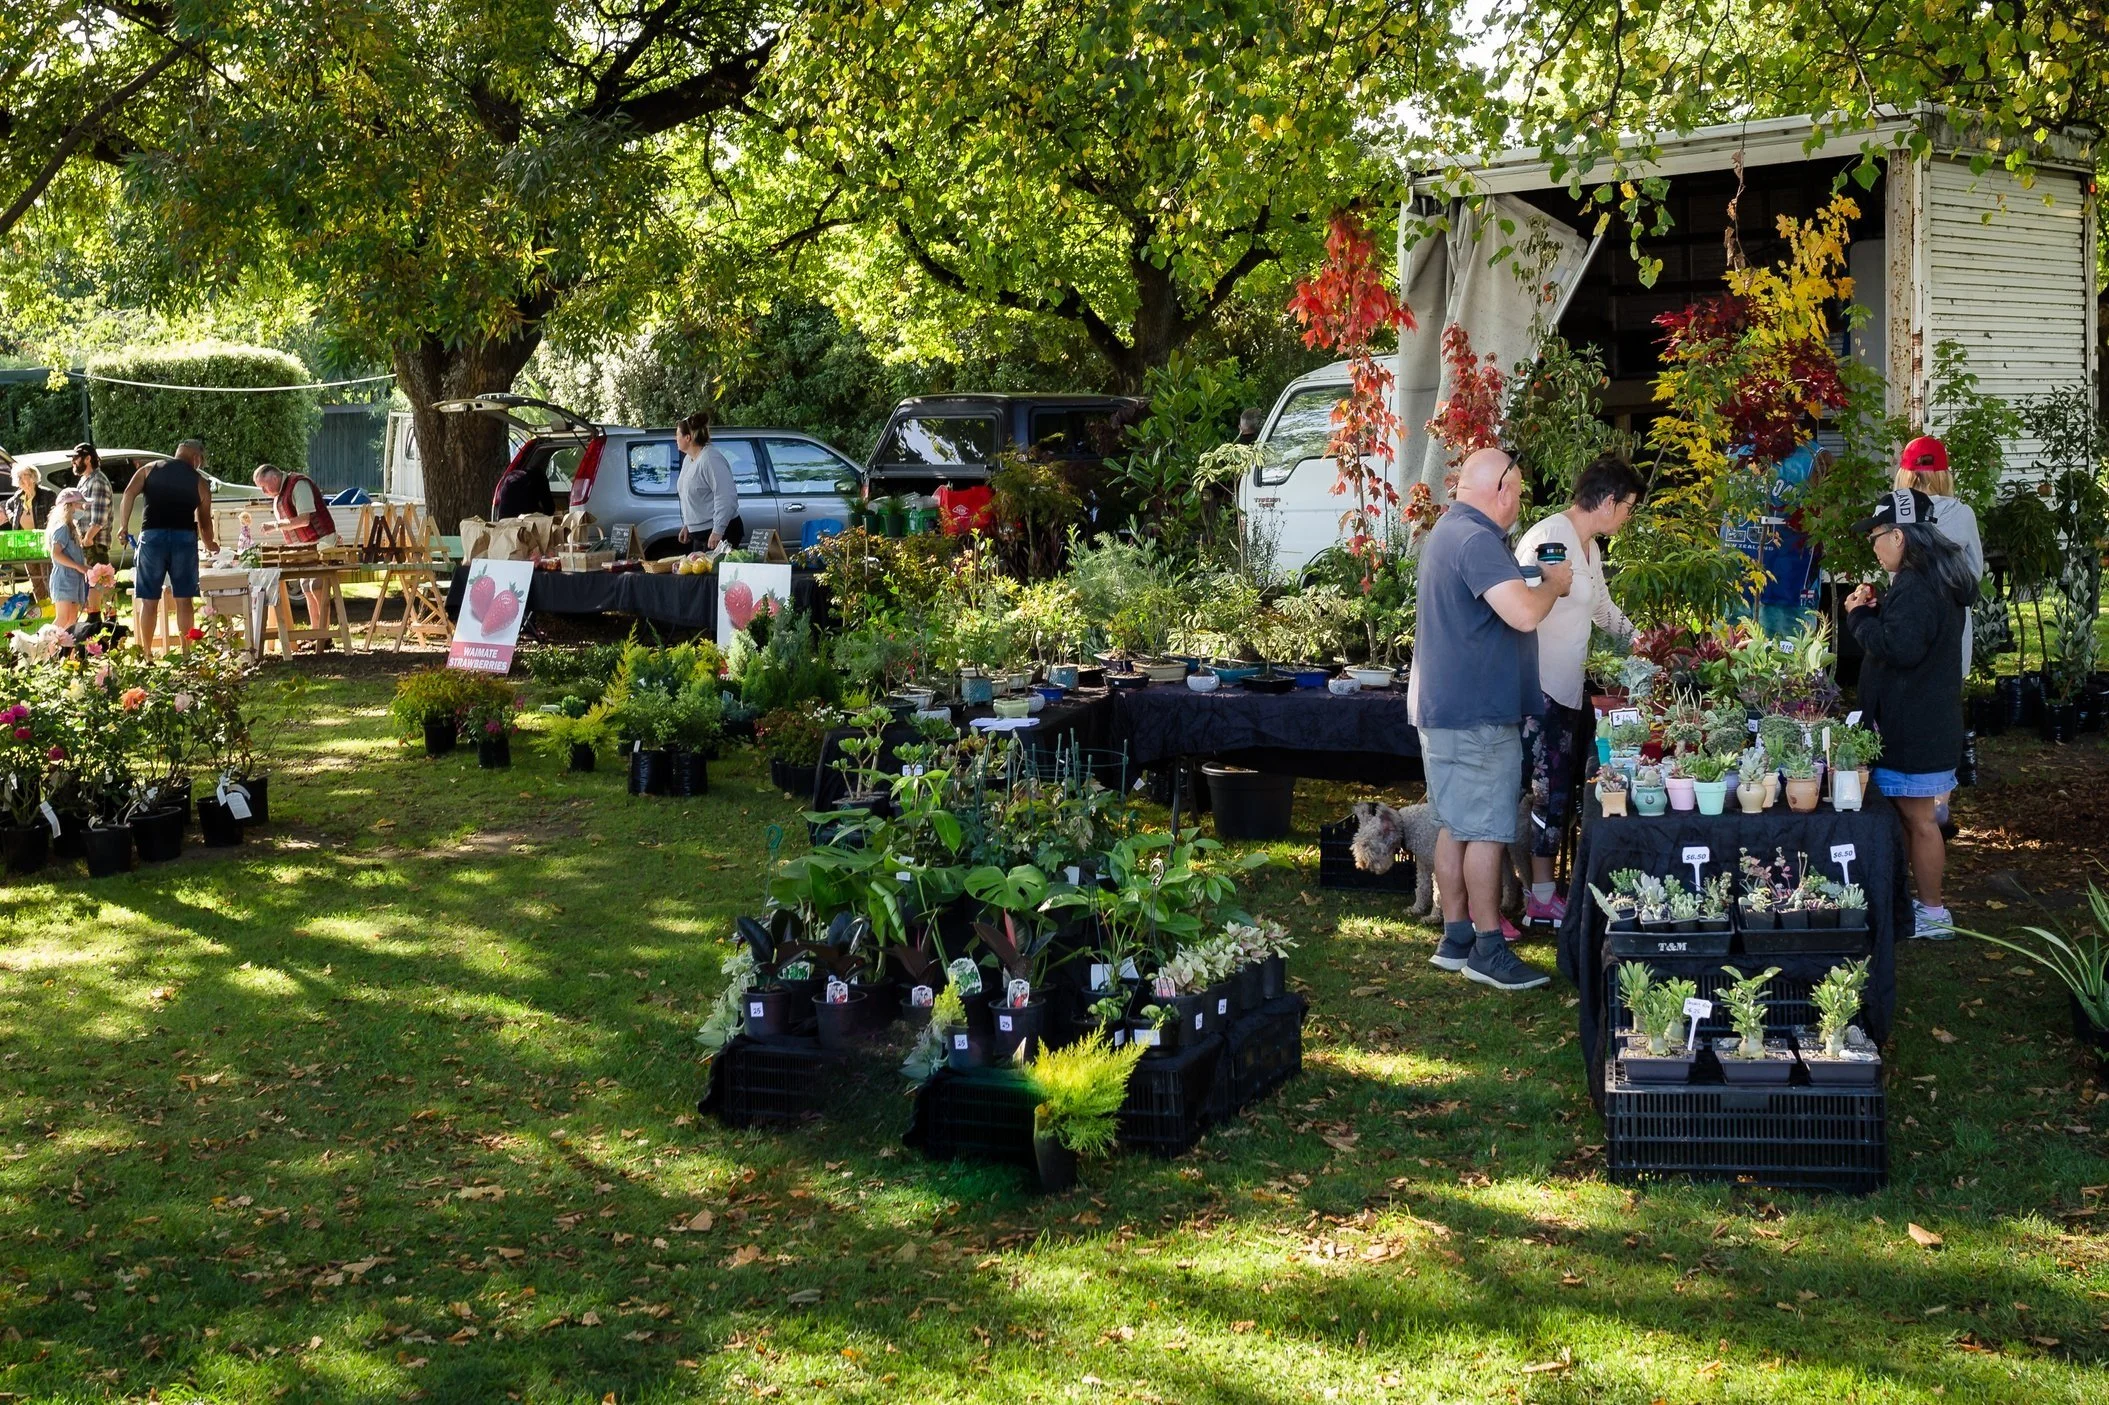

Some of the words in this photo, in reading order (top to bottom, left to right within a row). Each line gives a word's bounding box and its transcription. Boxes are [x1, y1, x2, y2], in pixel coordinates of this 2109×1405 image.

[463, 647, 499, 659] WAIMATE
[448, 657, 508, 671] STRAWBERRIES
[1685, 853, 1707, 861] $6.50
[1833, 850, 1853, 859] $6.50
[1657, 942, 1688, 952] T&M
